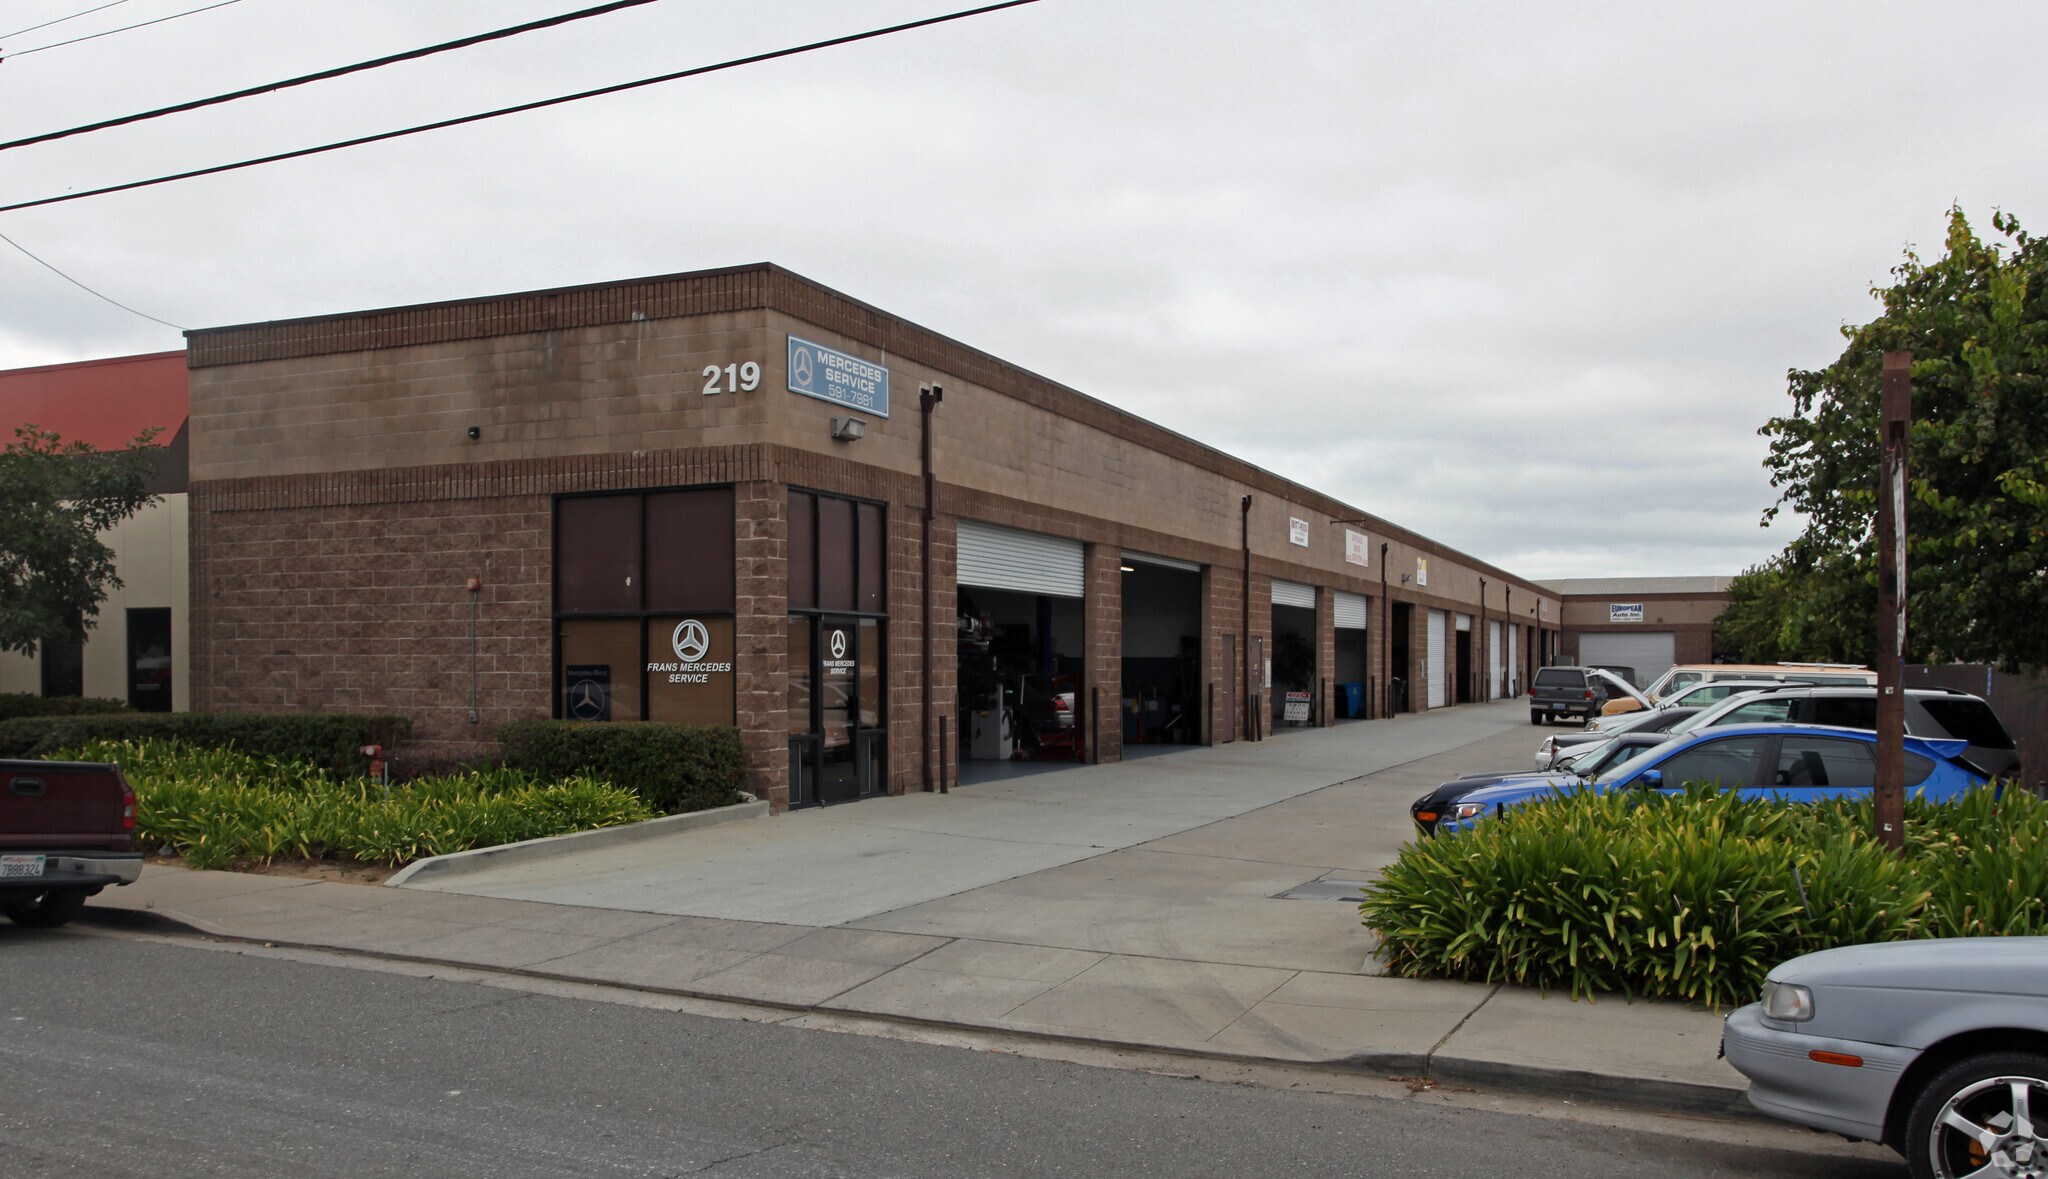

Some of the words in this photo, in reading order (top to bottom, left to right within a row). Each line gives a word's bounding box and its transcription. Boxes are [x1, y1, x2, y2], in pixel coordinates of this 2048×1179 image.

[817, 351, 882, 383] MERCEDES
[702, 361, 761, 395] 219
[825, 368, 875, 394] SERVICE
[828, 384, 873, 407] 591-7981
[1612, 604, 1642, 612] EUROPEAN
[567, 669, 608, 677] Mercedes-Benz
[647, 662, 678, 672] FRANS
[679, 662, 731, 672] MERCEDES
[668, 674, 709, 683] SERVICE
[2, 864, 41, 876] 7B88324
